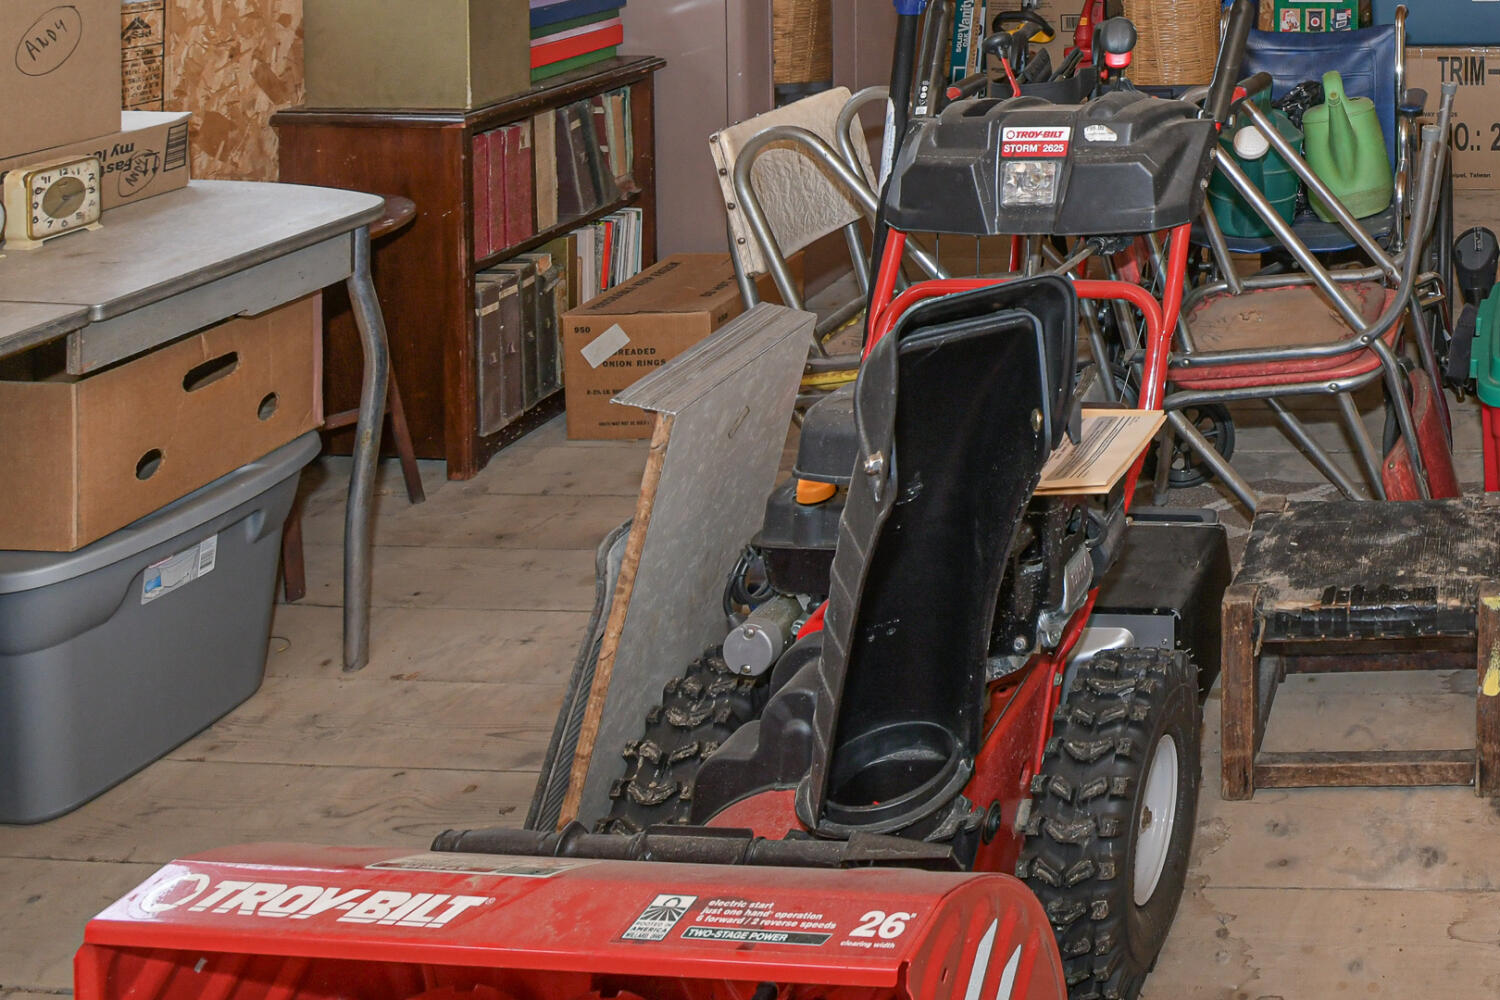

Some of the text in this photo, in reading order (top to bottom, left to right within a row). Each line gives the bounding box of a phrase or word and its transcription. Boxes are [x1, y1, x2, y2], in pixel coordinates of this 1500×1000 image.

[25, 18, 67, 62] ANDY
[1015, 130, 1064, 139] TROY-BILT
[1004, 144, 1064, 153] STORM 2625
[612, 348, 656, 356] READED
[602, 359, 666, 368] ONION RINGS
[190, 880, 489, 929] TROY-BILT
[708, 899, 774, 910] electric start
[700, 907, 722, 916] just
[774, 911, 823, 921] operation
[704, 916, 744, 925] forward
[760, 920, 797, 928] reverse
[800, 921, 837, 931] speeds
[631, 926, 669, 934] AMERICA
[689, 928, 788, 942] TWO-STAGE POWER
[840, 940, 895, 949] clearing width
